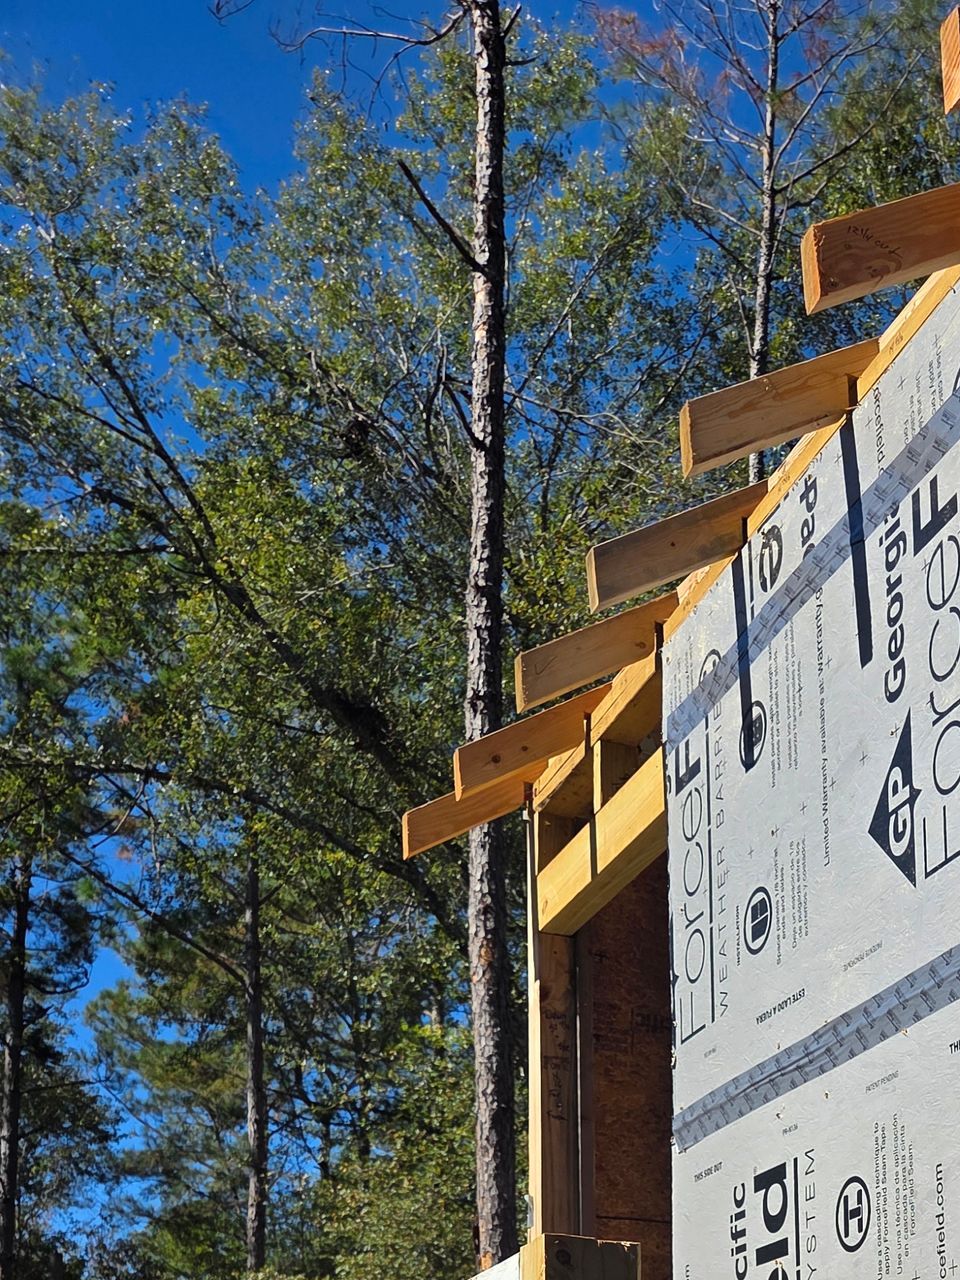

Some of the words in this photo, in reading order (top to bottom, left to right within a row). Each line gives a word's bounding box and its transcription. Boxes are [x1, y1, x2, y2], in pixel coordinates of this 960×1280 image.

[814, 587, 825, 676] warranty.g
[819, 697, 827, 754] available
[821, 757, 831, 816] Warranty
[887, 767, 912, 857] GP
[823, 819, 831, 867] Limited
[714, 846, 729, 1017] WEATHER
[755, 1008, 773, 1025] FUERA
[772, 1003, 780, 1015] A
[778, 994, 794, 1011] LADO
[792, 987, 805, 1003] ESTE
